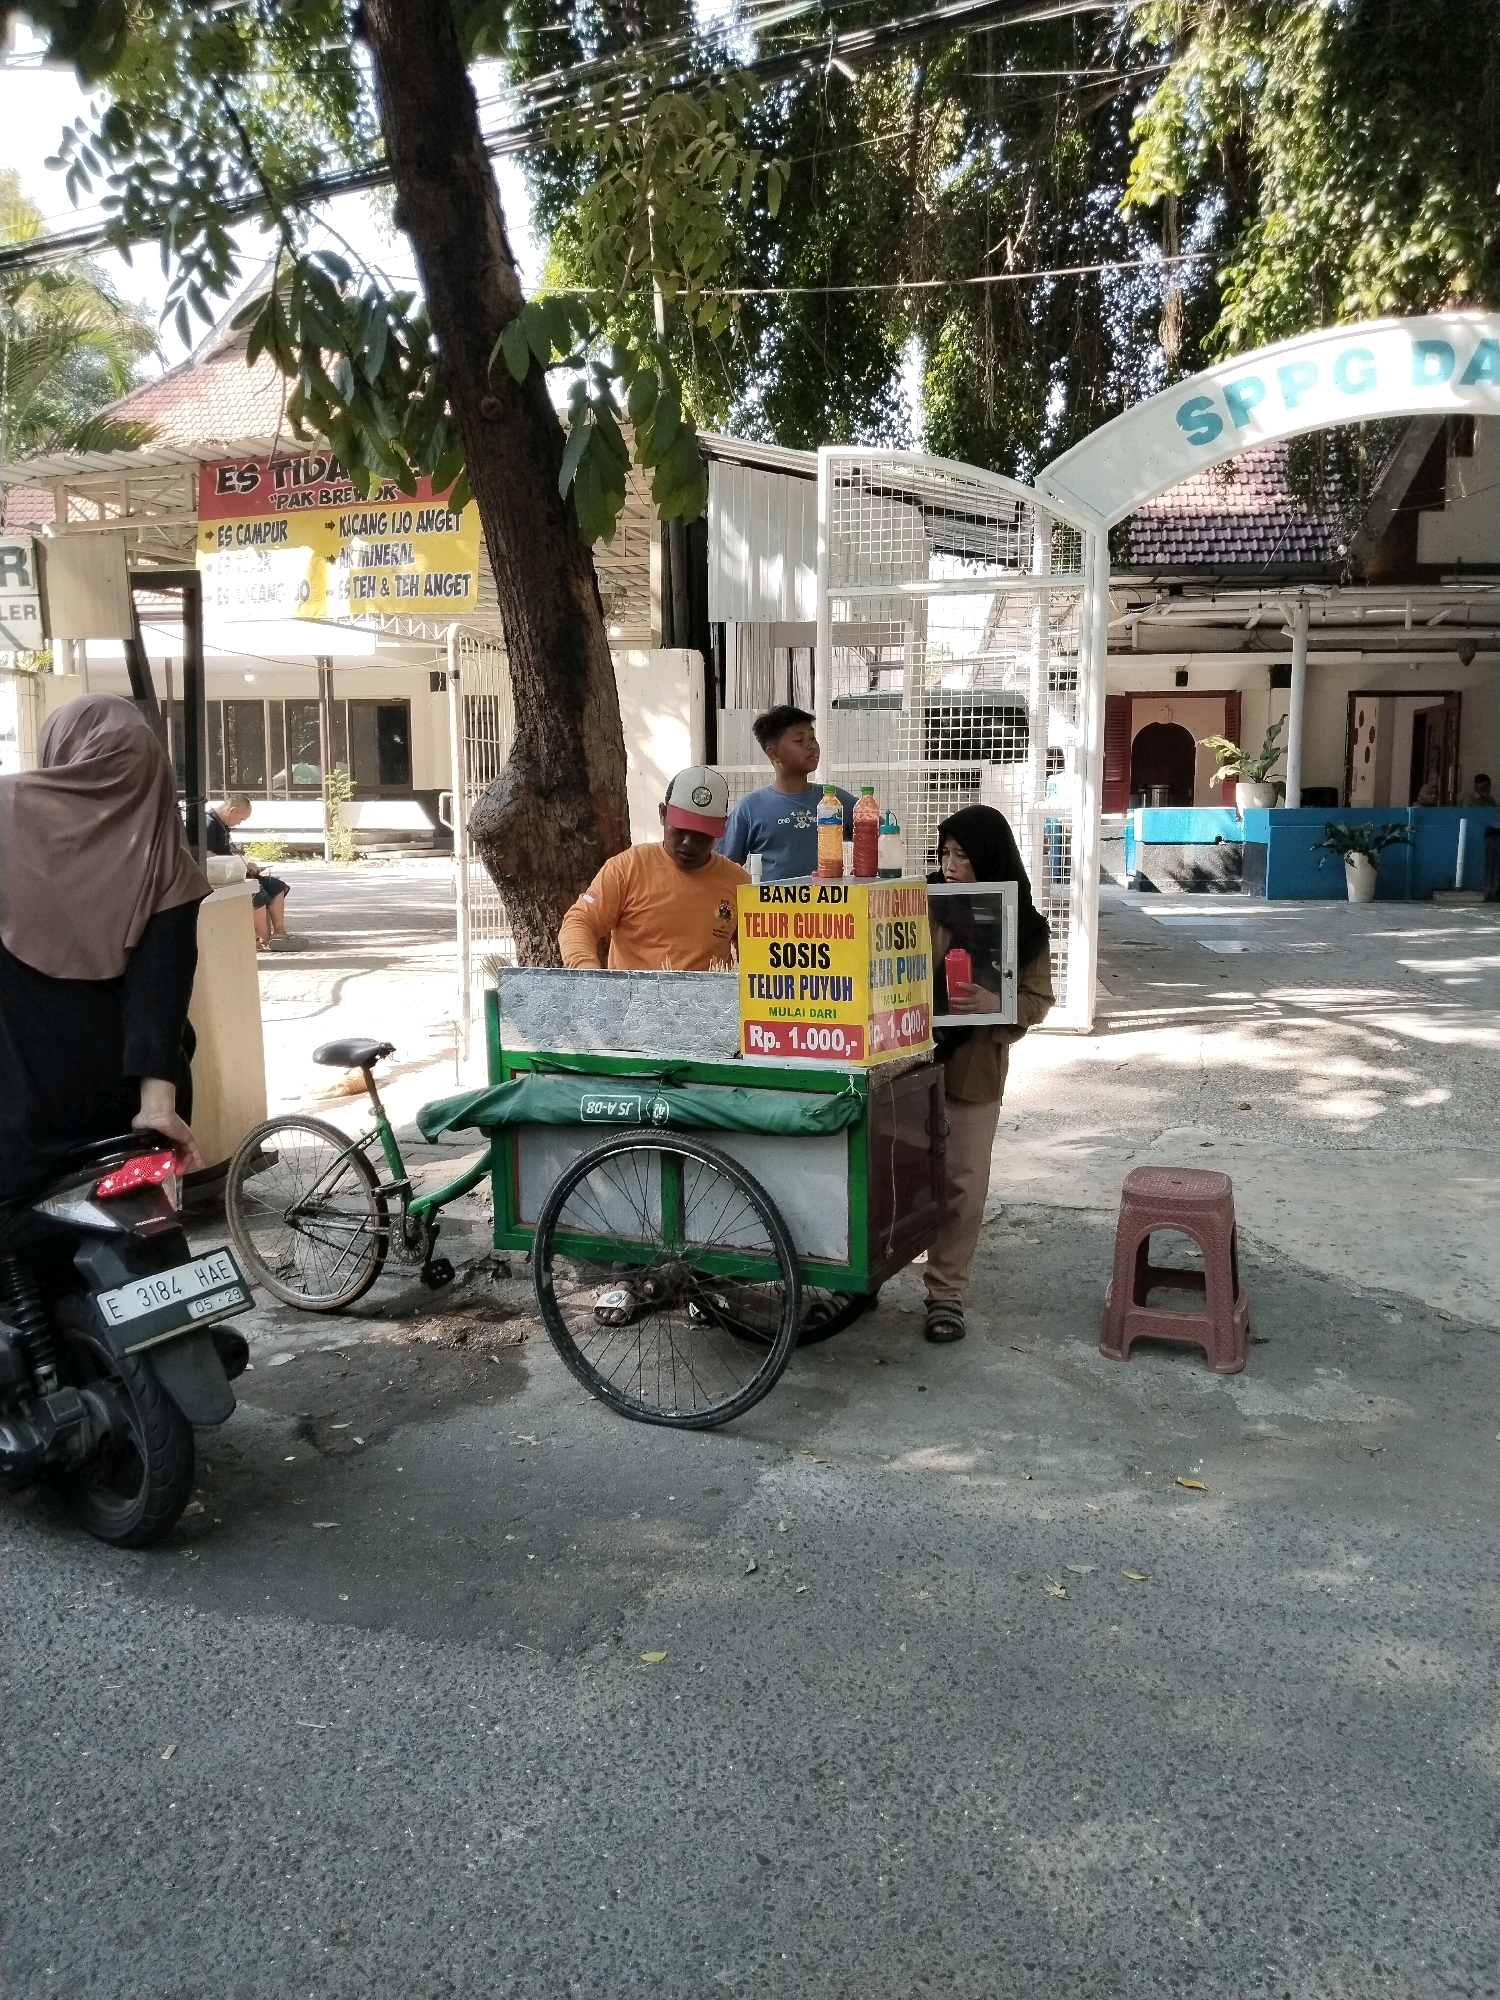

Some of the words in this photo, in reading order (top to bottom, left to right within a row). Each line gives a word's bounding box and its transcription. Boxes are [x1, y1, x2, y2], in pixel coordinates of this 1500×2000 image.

[1176, 347, 1378, 446] SPPG
[215, 463, 261, 495] ES
[217, 524, 232, 548] ES
[236, 519, 288, 546] CAMPUR
[391, 510, 412, 534] IJO
[416, 508, 463, 533] ANGET
[356, 542, 416, 567] MINERAL
[353, 574, 376, 599] TEH
[395, 573, 419, 598] TEH
[423, 572, 472, 598] ANGET
[759, 885, 811, 903] BANG
[816, 885, 848, 904] ADI
[868, 890, 890, 919] ELUR
[744, 912, 788, 938] TELUR
[793, 912, 855, 939] GULUNG
[876, 921, 917, 952] SOSIS
[769, 942, 830, 969] SOSIS
[748, 974, 795, 1000] TELUR
[800, 975, 853, 1001] PUYUH
[868, 958, 893, 990] ELUR
[768, 1006, 805, 1018] MULAI
[809, 1008, 837, 1019] DARI
[750, 1025, 781, 1053] Rp.
[788, 1026, 858, 1056] 1.000,-
[106, 1297, 123, 1319] E
[136, 1276, 182, 1307] 3184
[194, 1260, 231, 1287] HAE
